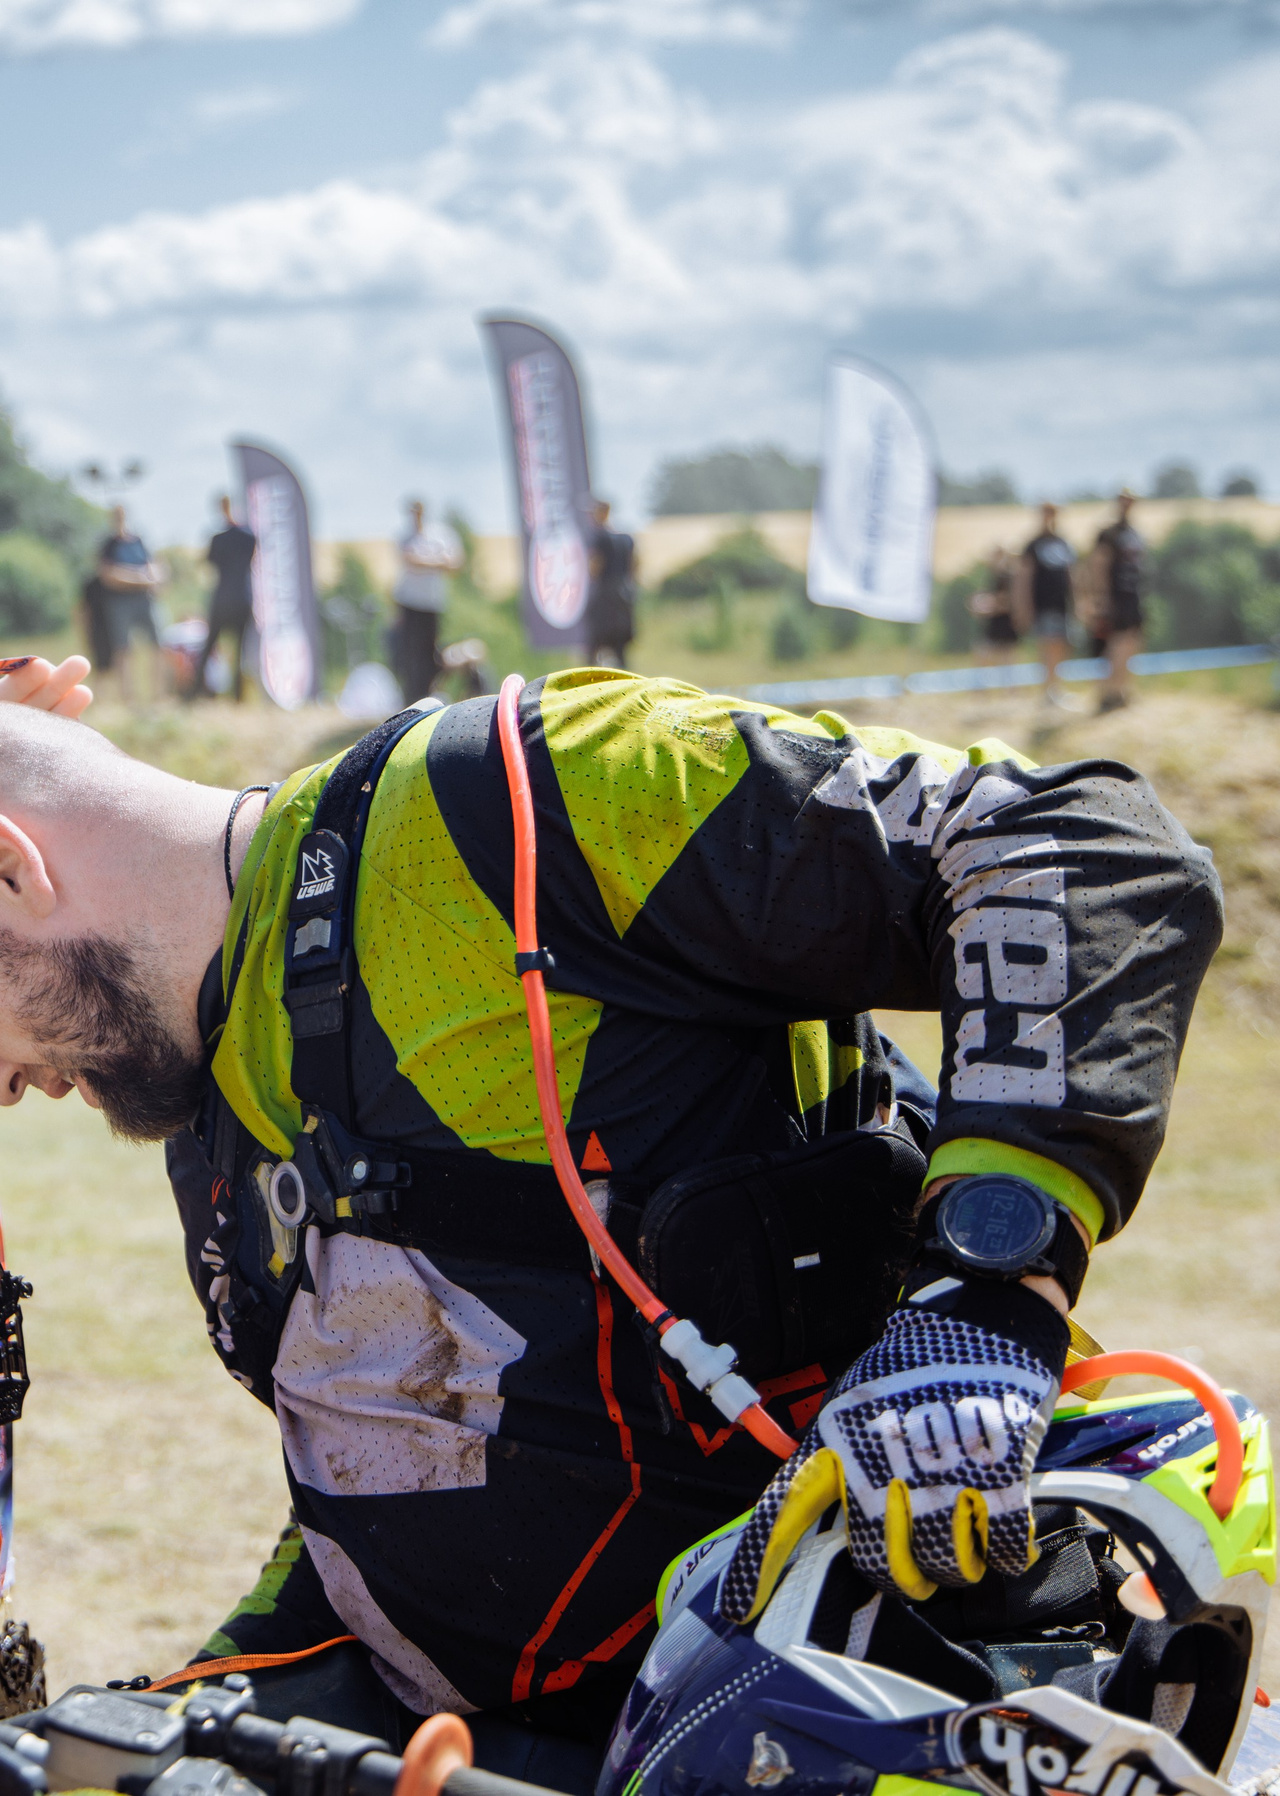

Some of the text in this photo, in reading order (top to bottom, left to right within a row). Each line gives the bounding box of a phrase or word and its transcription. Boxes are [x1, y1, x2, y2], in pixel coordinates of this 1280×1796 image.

[296, 879, 335, 900] USWE
[869, 1391, 1030, 1482] 100
[1137, 1411, 1213, 1461] Airoh
